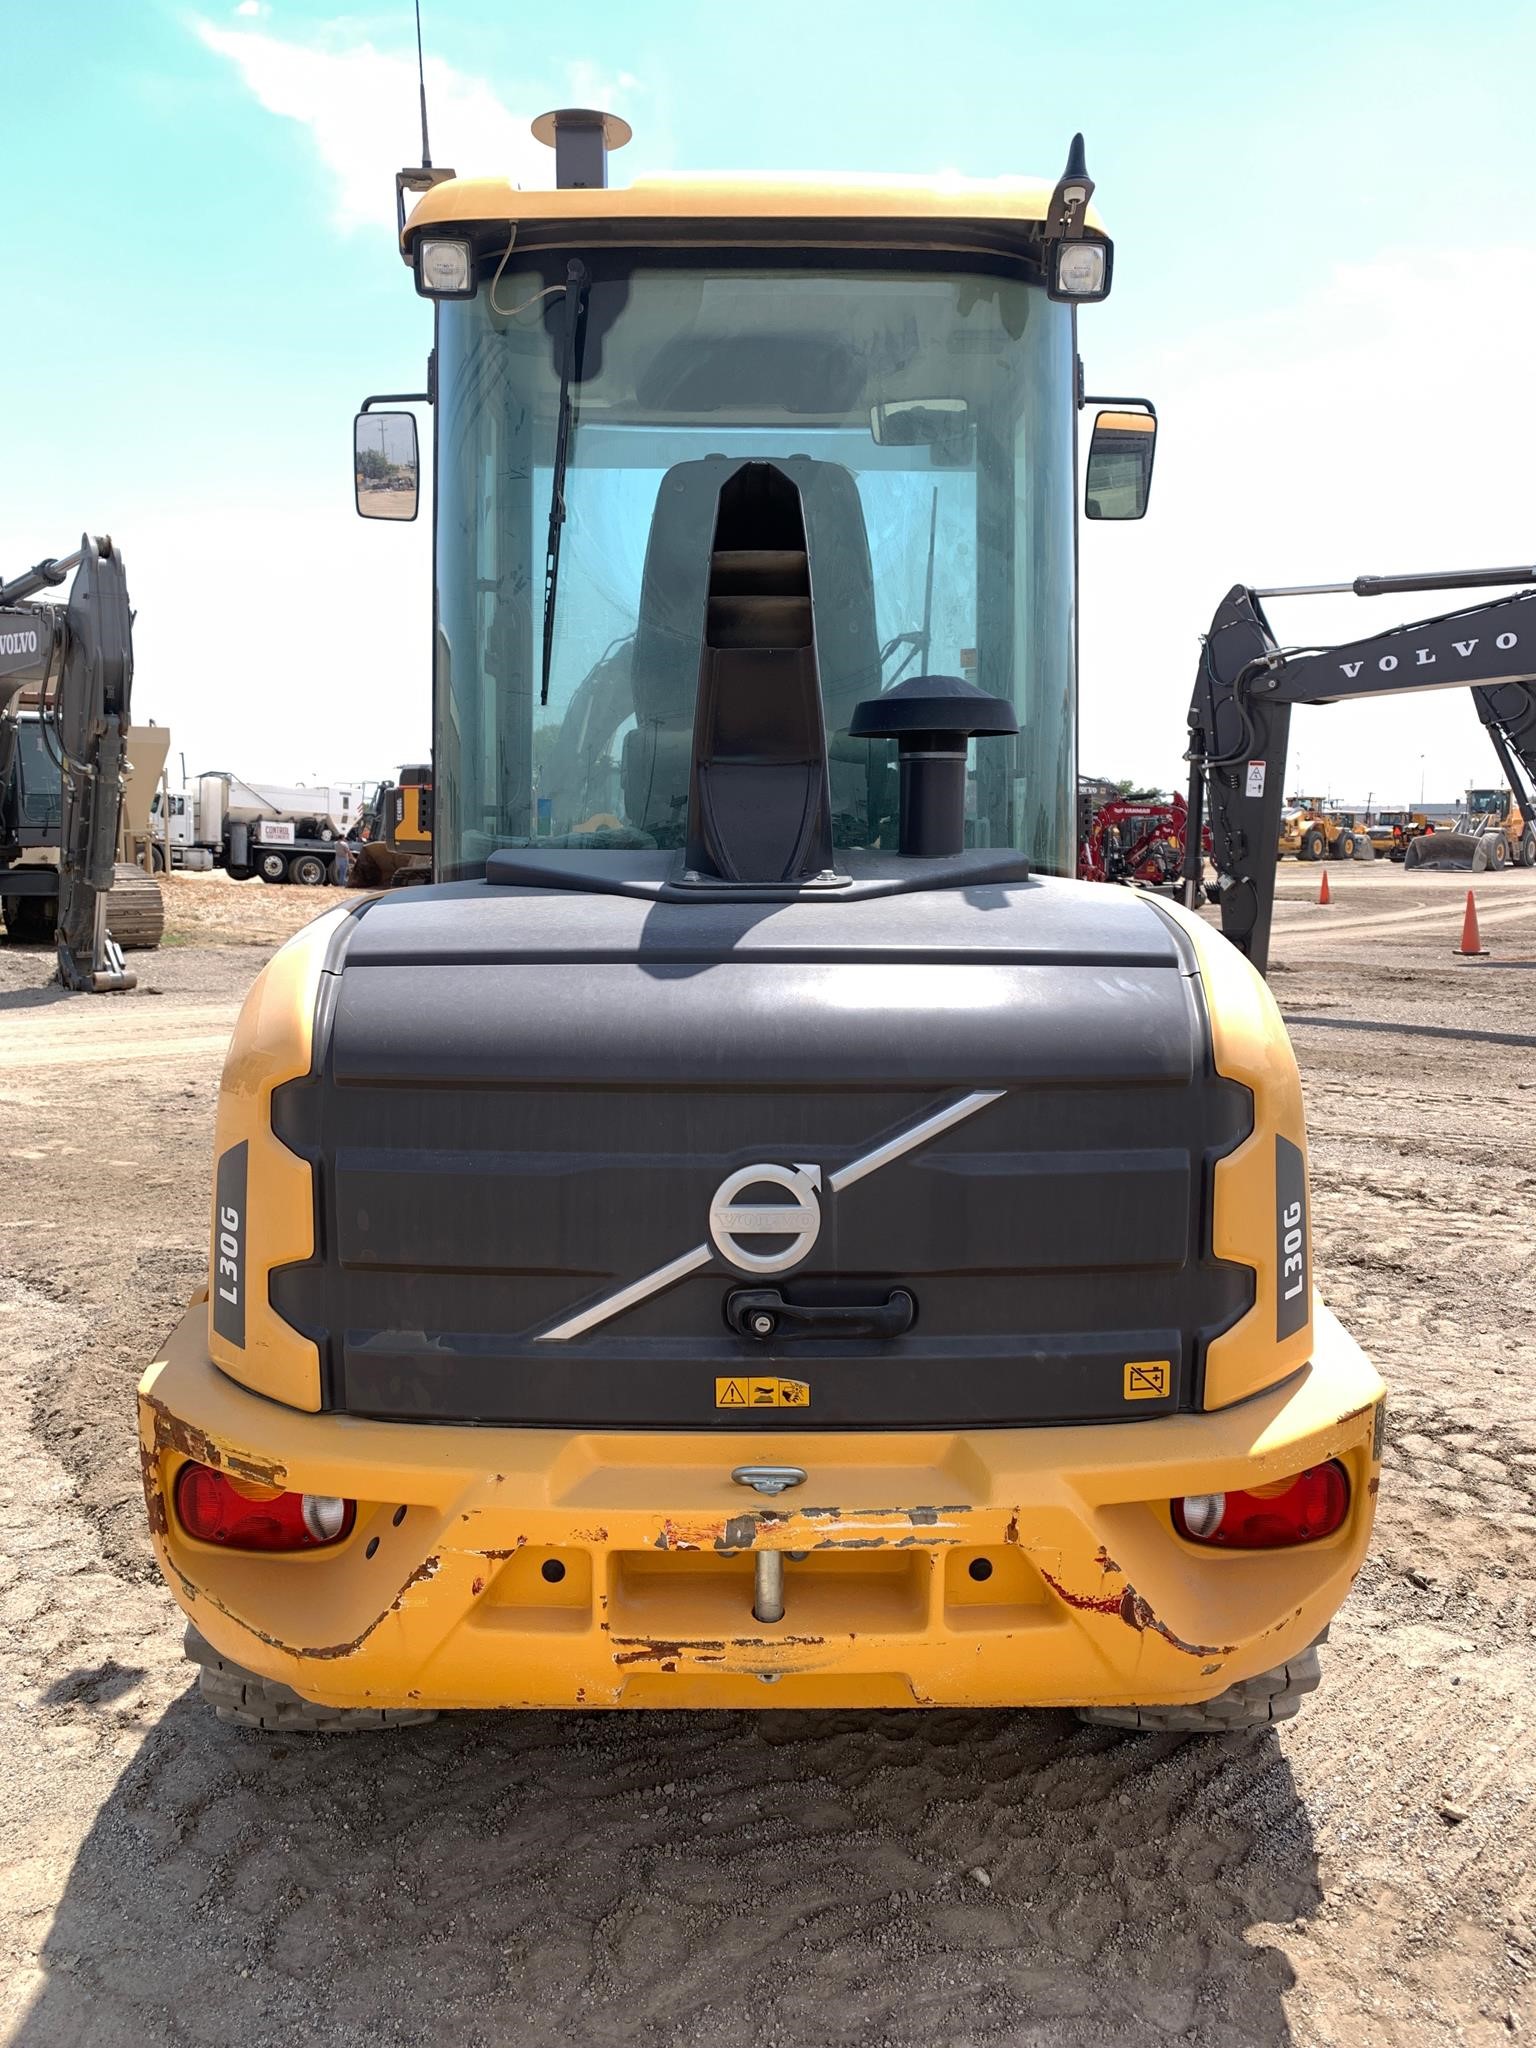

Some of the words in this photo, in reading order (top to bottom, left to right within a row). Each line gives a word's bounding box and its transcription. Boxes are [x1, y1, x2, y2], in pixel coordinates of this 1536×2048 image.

[0, 631, 37, 655] VOLVO
[1339, 632, 1518, 678] VOLVO
[265, 826, 289, 835] CONTROL
[715, 1212, 816, 1227] VOLVO
[219, 1206, 239, 1305] L30G
[1283, 1201, 1303, 1300] L30G
